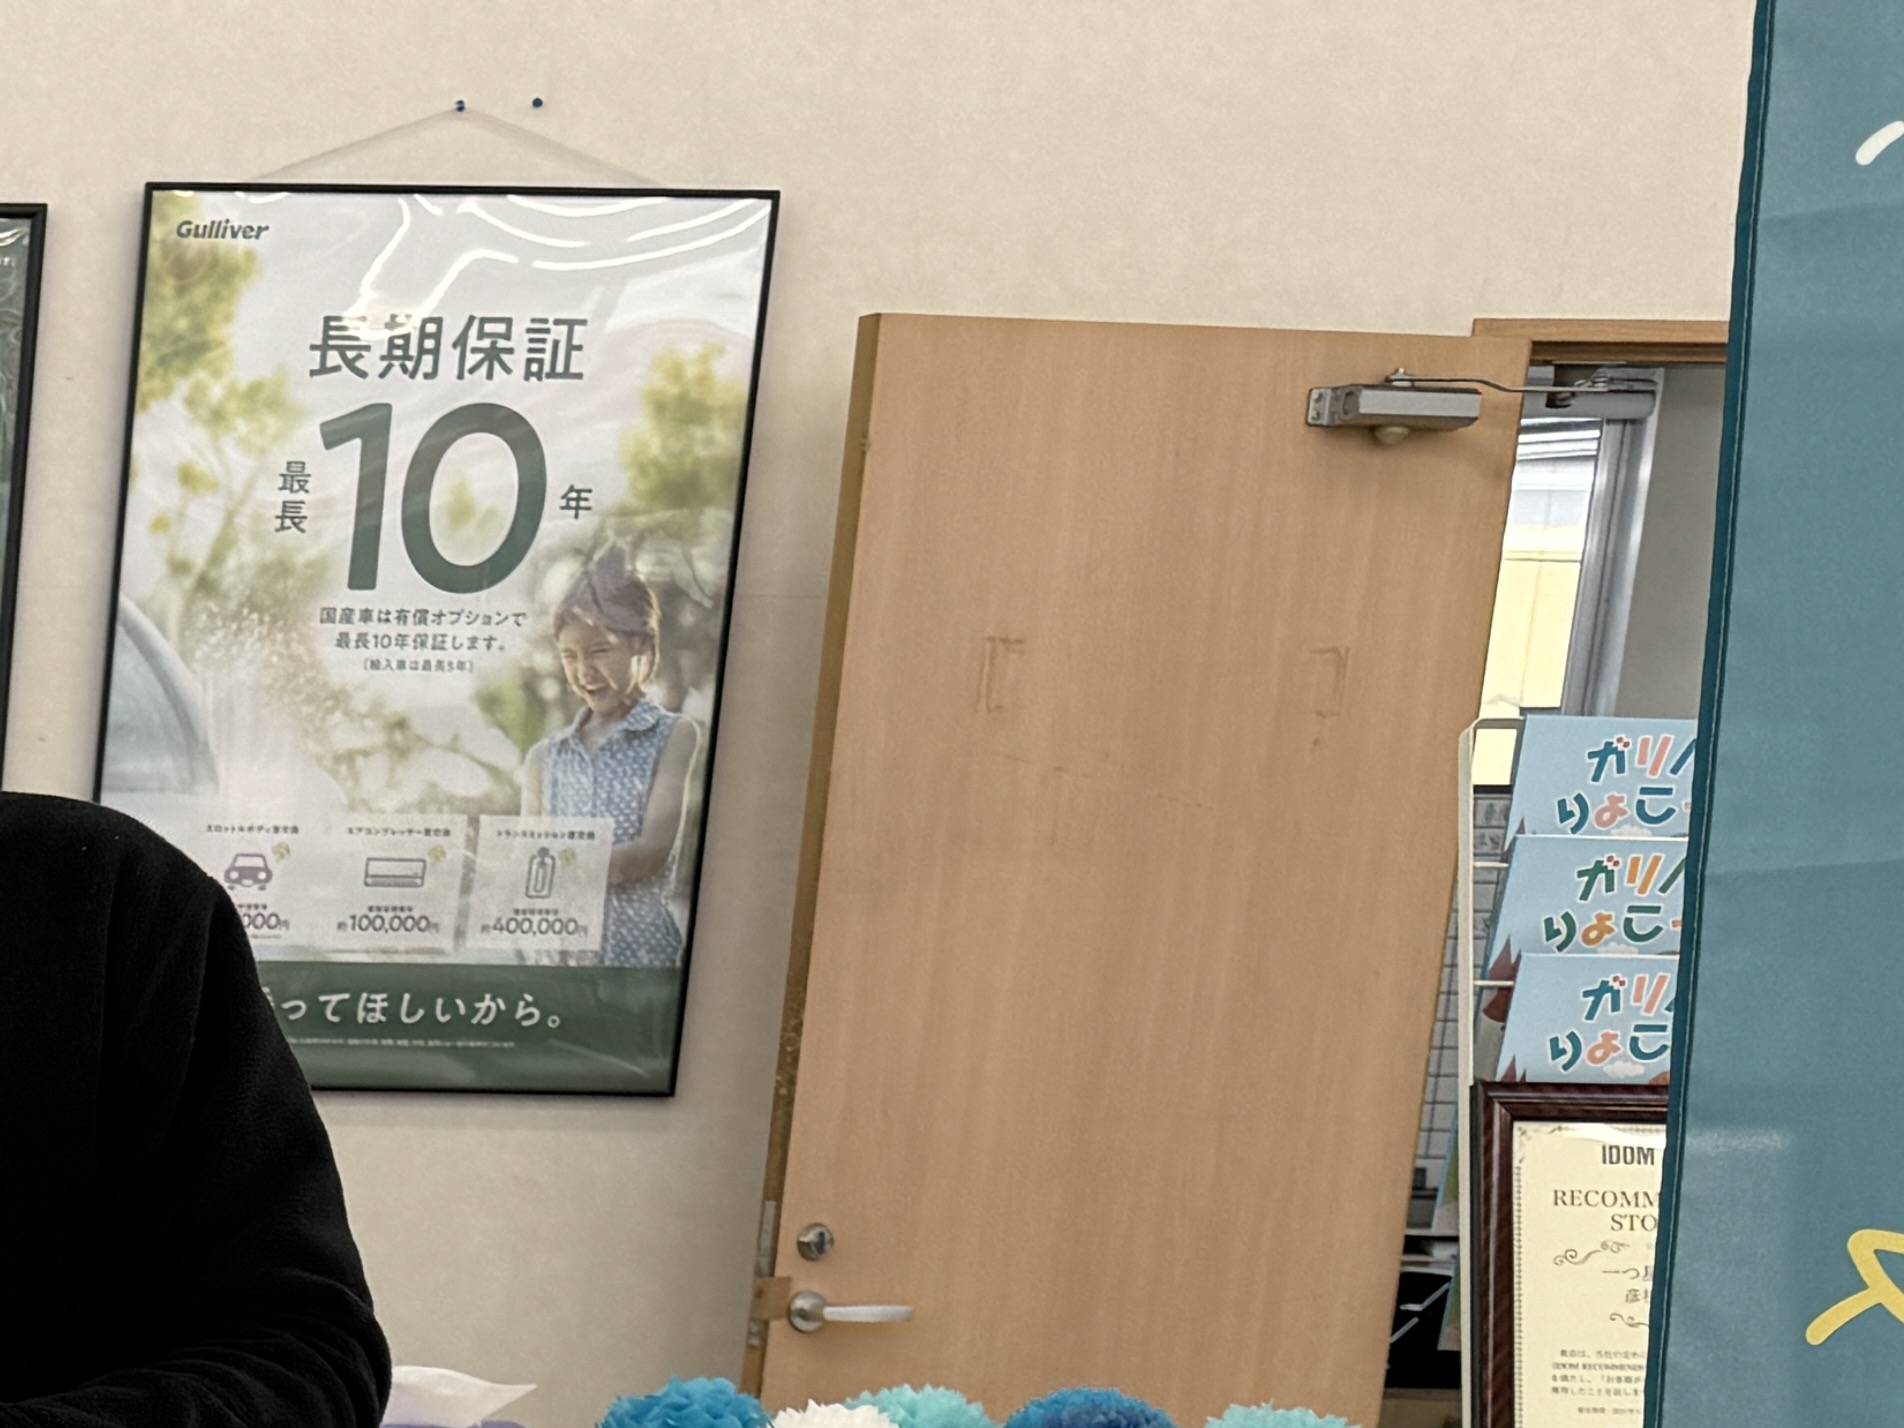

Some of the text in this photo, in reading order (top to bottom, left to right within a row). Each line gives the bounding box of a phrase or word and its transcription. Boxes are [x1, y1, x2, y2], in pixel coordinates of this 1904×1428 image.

[176, 218, 269, 240] Gulliver
[309, 314, 588, 382] 長期保証
[275, 460, 312, 533] 最長
[319, 402, 547, 596] 10
[559, 484, 593, 520] 年
[320, 606, 527, 628] 国産車は有償オプションで
[335, 631, 505, 652] 最長10年保証します。
[261, 986, 560, 1029] ってほしいから。
[1601, 1144, 1655, 1165] IDOM
